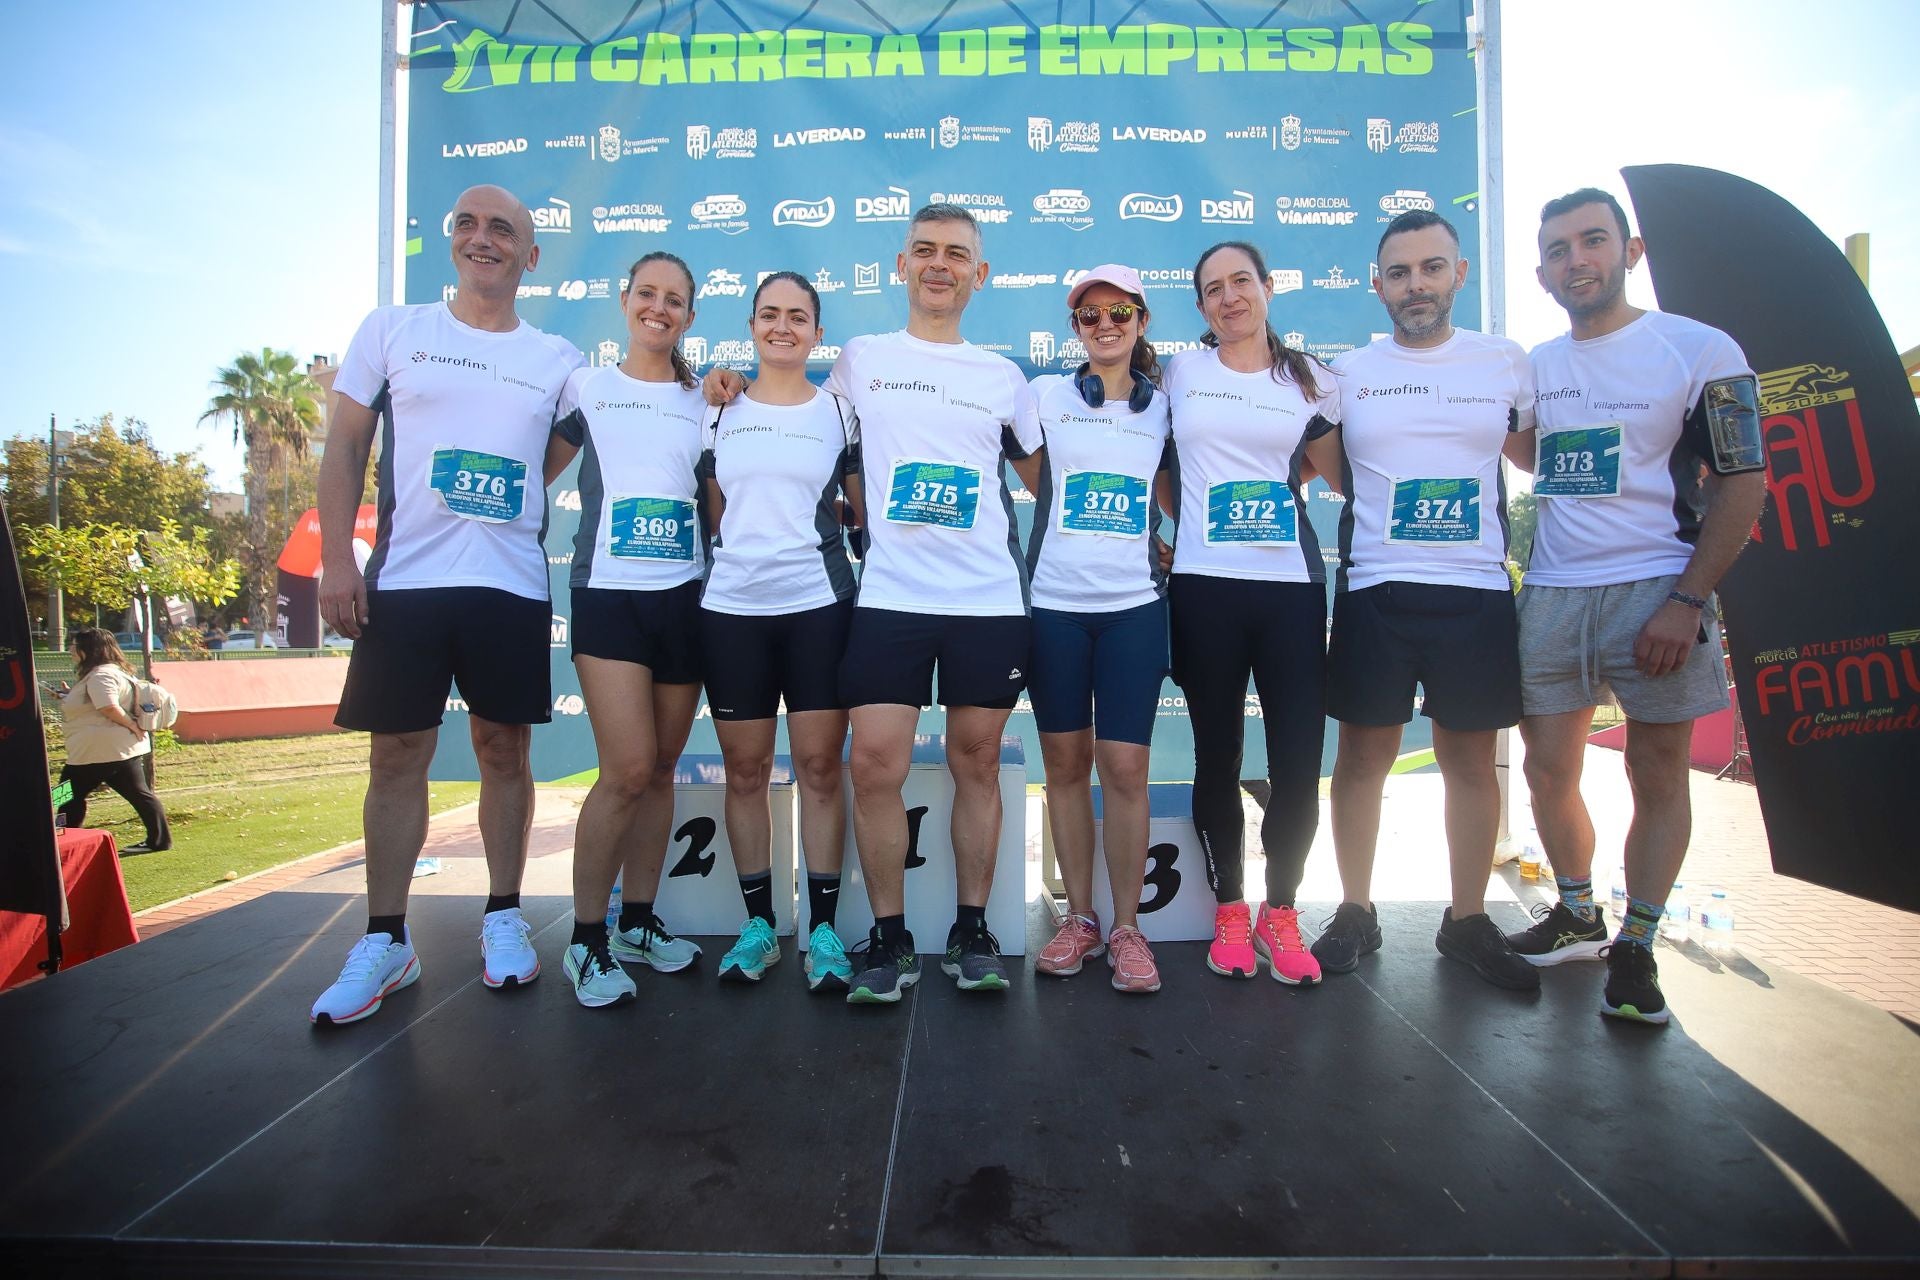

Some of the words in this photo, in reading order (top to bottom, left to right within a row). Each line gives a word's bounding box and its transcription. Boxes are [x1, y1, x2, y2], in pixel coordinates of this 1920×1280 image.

[591, 29, 925, 86] CARRERA
[937, 26, 1027, 76] DE
[1039, 22, 1434, 77] EMPRESAS
[717, 132, 757, 141] murcia
[962, 125, 1011, 135] Ayuntamiento
[1060, 126, 1100, 135] murcia
[1113, 127, 1136, 141] LA
[1137, 126, 1206, 143] VERDAD
[1225, 131, 1268, 139] MURCIA
[1303, 127, 1350, 137] Ayuntamiento
[1399, 126, 1439, 135] murcia
[545, 140, 586, 148] MURCIA
[623, 136, 670, 146] Ayuntamiento
[712, 140, 757, 148] ATLETISMO
[773, 133, 796, 148] LA
[796, 128, 866, 146] VERDAD
[962, 133, 971, 141] de
[972, 133, 1000, 142] Murcia
[1055, 134, 1100, 142] ATLETISMO
[1313, 136, 1340, 144] Murcia
[1394, 135, 1439, 143] ATLETISMO
[442, 144, 464, 158] LA
[465, 138, 528, 157] VERDAD
[623, 147, 631, 155] de
[632, 145, 658, 154] Murcia
[856, 197, 910, 216] DSM
[971, 194, 1005, 206] GLOBAL
[1317, 198, 1351, 208] GLOBAL
[630, 204, 665, 215] GLOBAL
[783, 206, 827, 220] VIDAL
[1129, 201, 1174, 214] VIDAL
[1201, 200, 1253, 219] DSM
[992, 272, 1057, 287] atalayas
[709, 352, 755, 361] ATLETISMO
[430, 355, 487, 371] eurofins
[502, 376, 546, 394] Villapharma
[884, 380, 936, 393] eurofins
[950, 398, 993, 415] Villapharma
[1198, 391, 1243, 401] eurofins
[1372, 383, 1430, 397] eurofins
[1447, 396, 1496, 404] Villapharma
[1540, 387, 1581, 401] eurofins
[1594, 401, 1650, 411] Villapharma
[608, 402, 651, 410] eurofins
[1786, 392, 1839, 410] 2025
[1073, 416, 1113, 425] eurofins
[731, 425, 773, 435] eurofins
[1554, 451, 1594, 472] 373
[454, 470, 506, 496] 376
[911, 481, 958, 505] 375
[1084, 491, 1129, 512] 370
[1229, 500, 1276, 520] 372
[1414, 499, 1463, 519] 374
[632, 516, 678, 538] 369
[1802, 634, 1887, 657] ATLETISMO
[1755, 651, 1798, 664] murcia
[1816, 712, 1837, 724] Cien
[1787, 704, 1920, 746] Corriend
[668, 816, 716, 878] 2
[1136, 843, 1181, 914] 3
